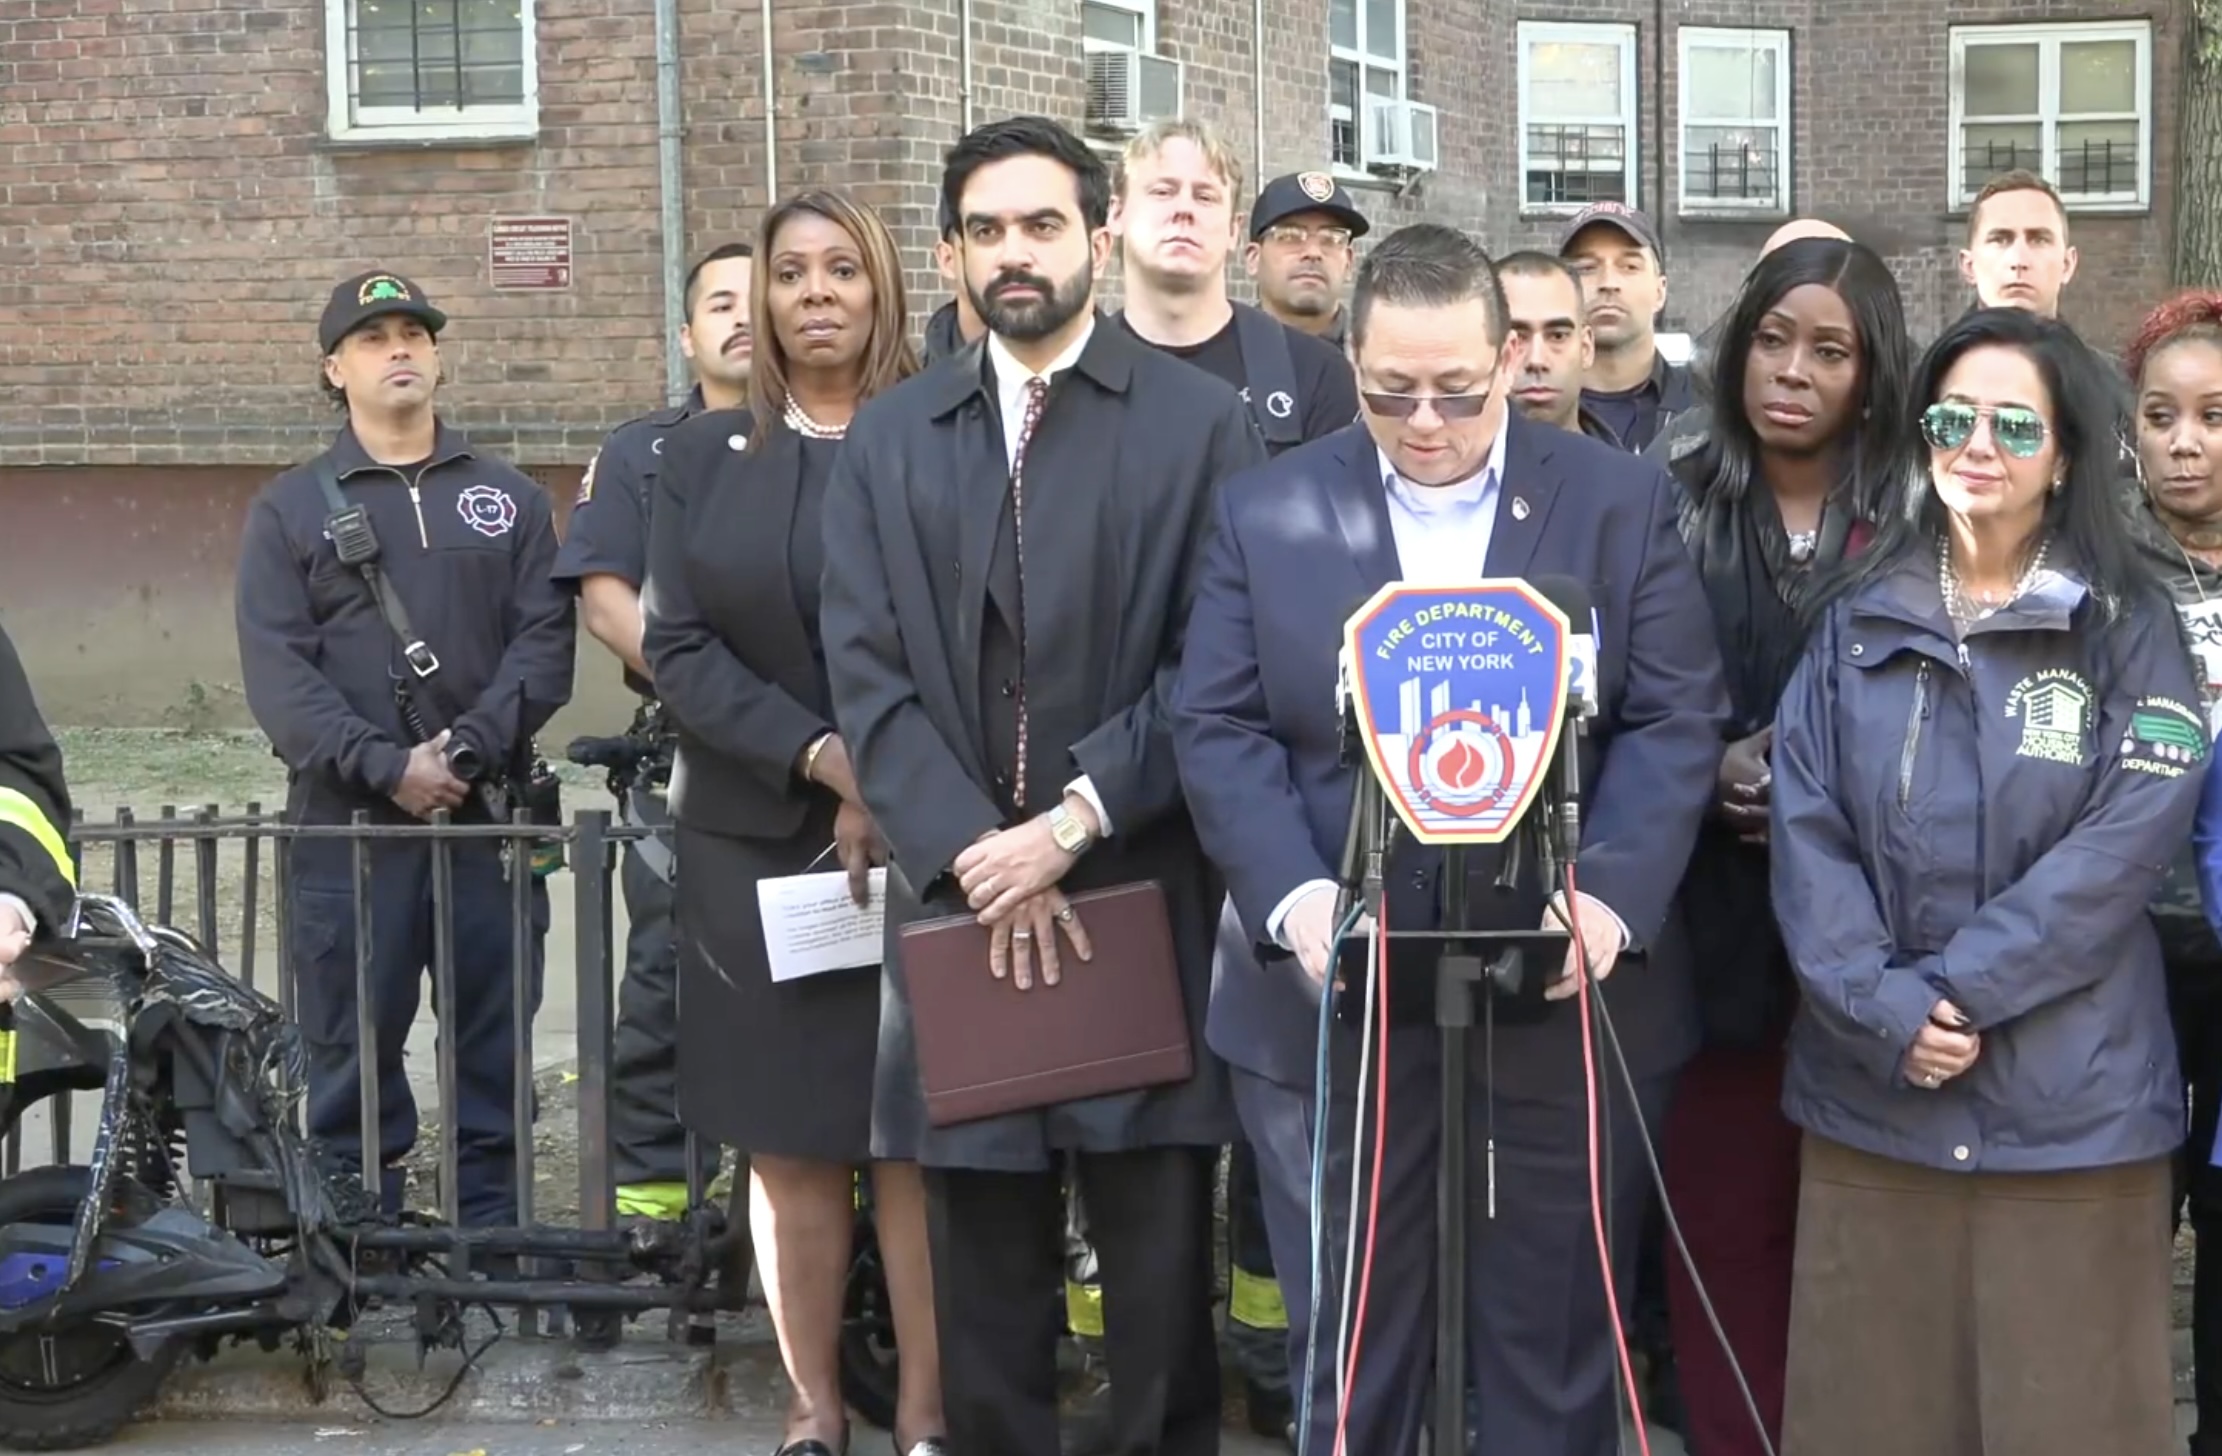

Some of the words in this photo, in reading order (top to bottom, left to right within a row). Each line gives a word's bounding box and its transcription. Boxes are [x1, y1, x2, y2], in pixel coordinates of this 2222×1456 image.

[475, 504, 498, 514] L-17
[1376, 619, 1415, 660] FIRE
[1415, 602, 1543, 655] DEPARTMENT
[1421, 632, 1467, 649] CITY
[1471, 631, 1499, 648] OF
[1407, 655, 1453, 672] NEW
[1458, 654, 1514, 670] YORK
[2004, 677, 2034, 718] WASTE
[2015, 744, 2083, 766] AUTHORITY
[2121, 758, 2185, 778] DEPARTME
